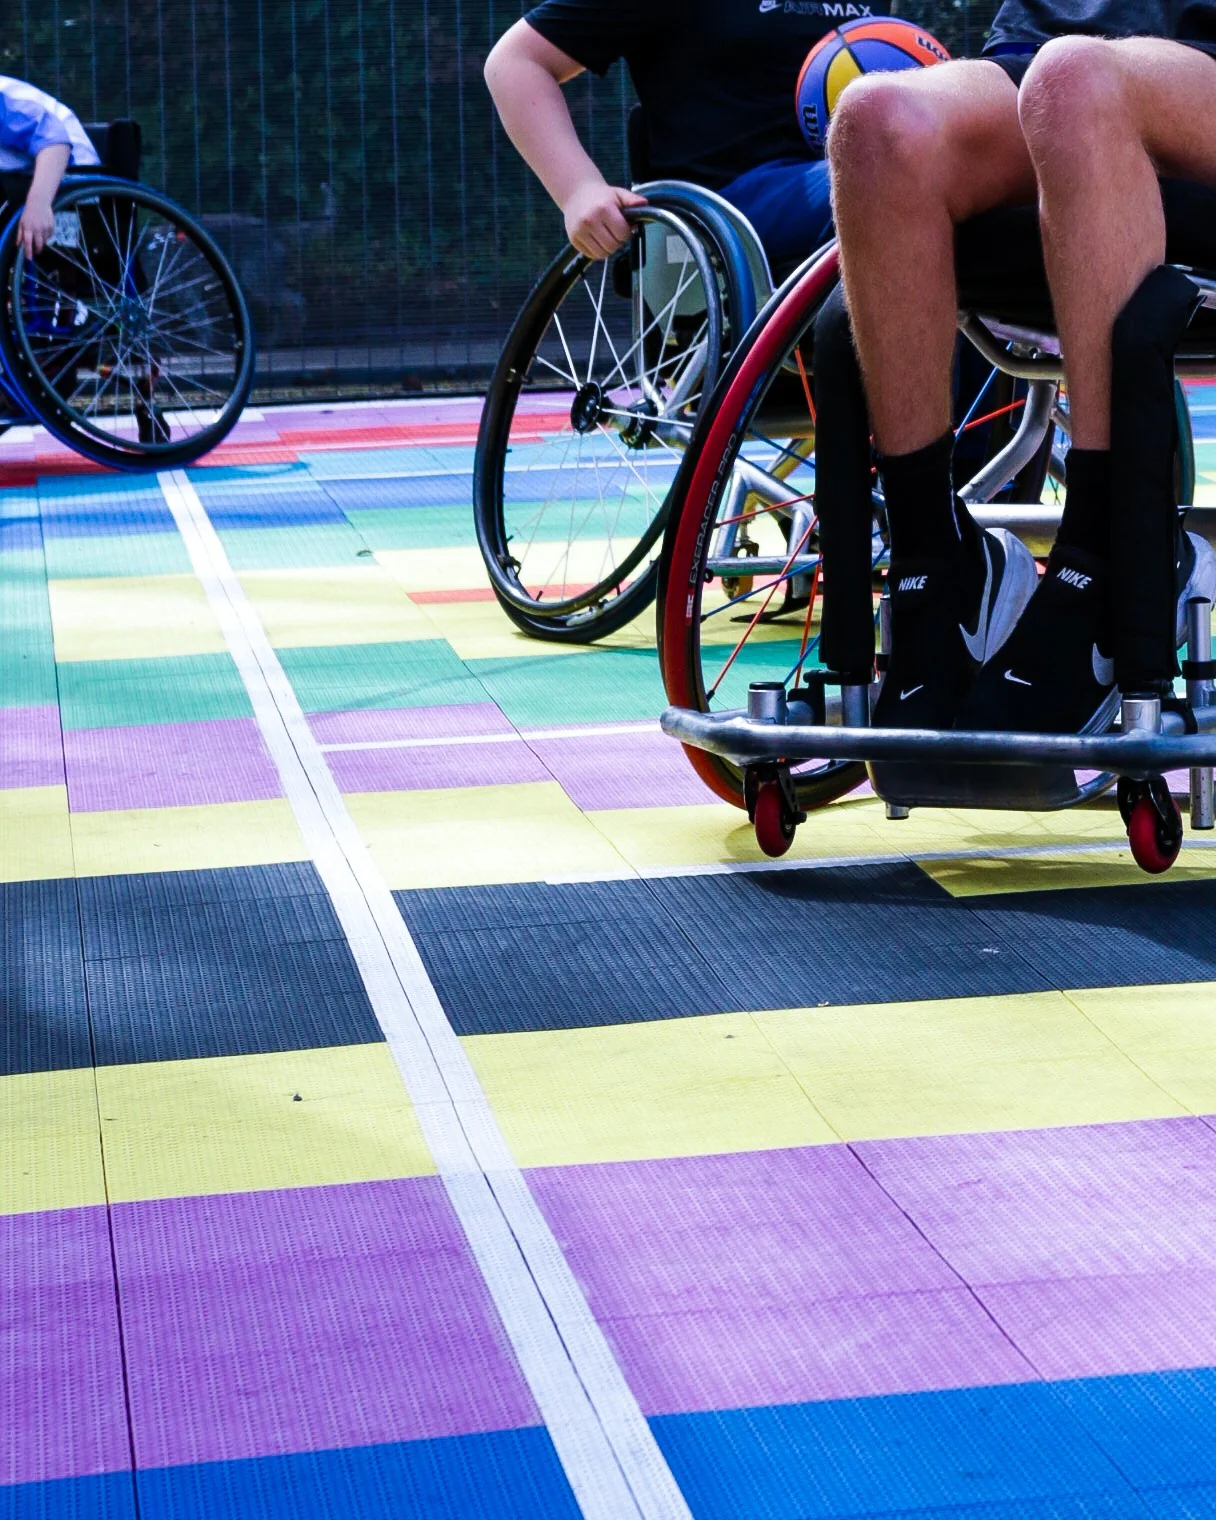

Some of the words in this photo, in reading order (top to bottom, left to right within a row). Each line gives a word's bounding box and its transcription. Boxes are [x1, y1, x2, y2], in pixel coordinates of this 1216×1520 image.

[718, 433, 738, 474] PRO
[898, 575, 928, 591] NIKE
[1056, 566, 1093, 589] NIKE
